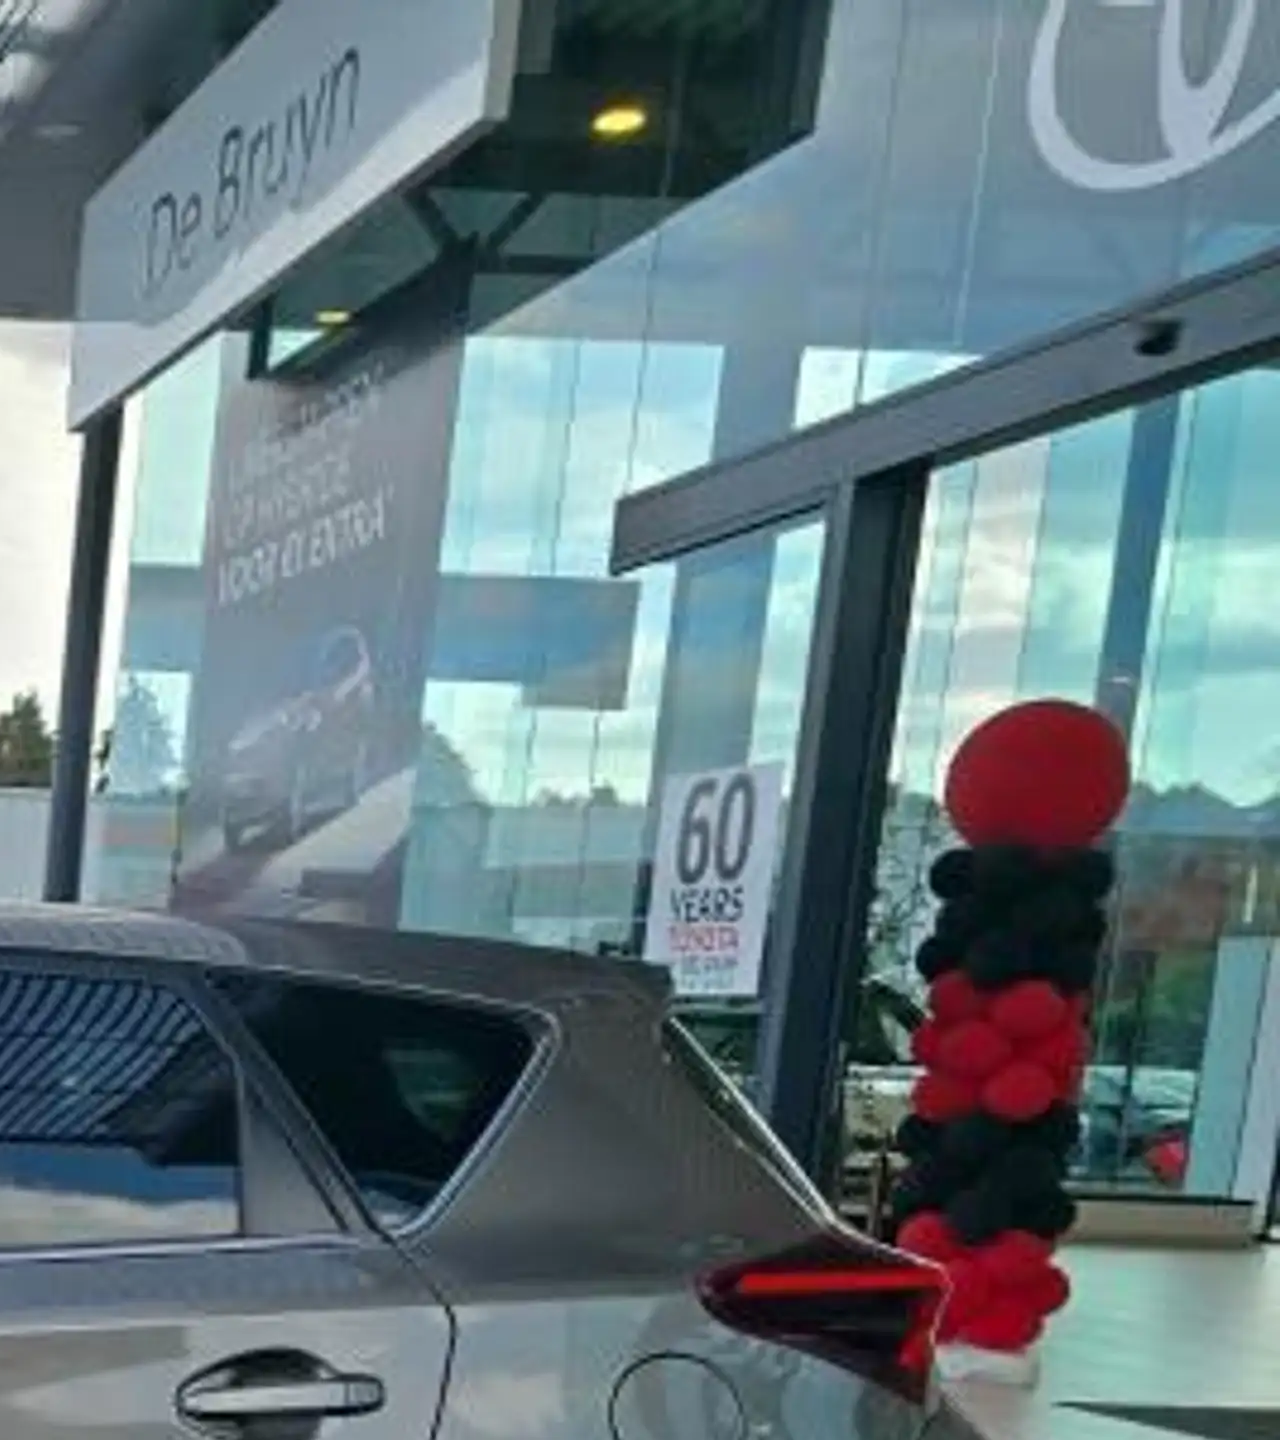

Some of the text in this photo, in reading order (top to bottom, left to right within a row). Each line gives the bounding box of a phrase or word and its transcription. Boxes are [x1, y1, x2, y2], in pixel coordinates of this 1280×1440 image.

[146, 46, 360, 294] De Bruyn
[676, 772, 756, 886] 60
[668, 883, 745, 923] YEARS
